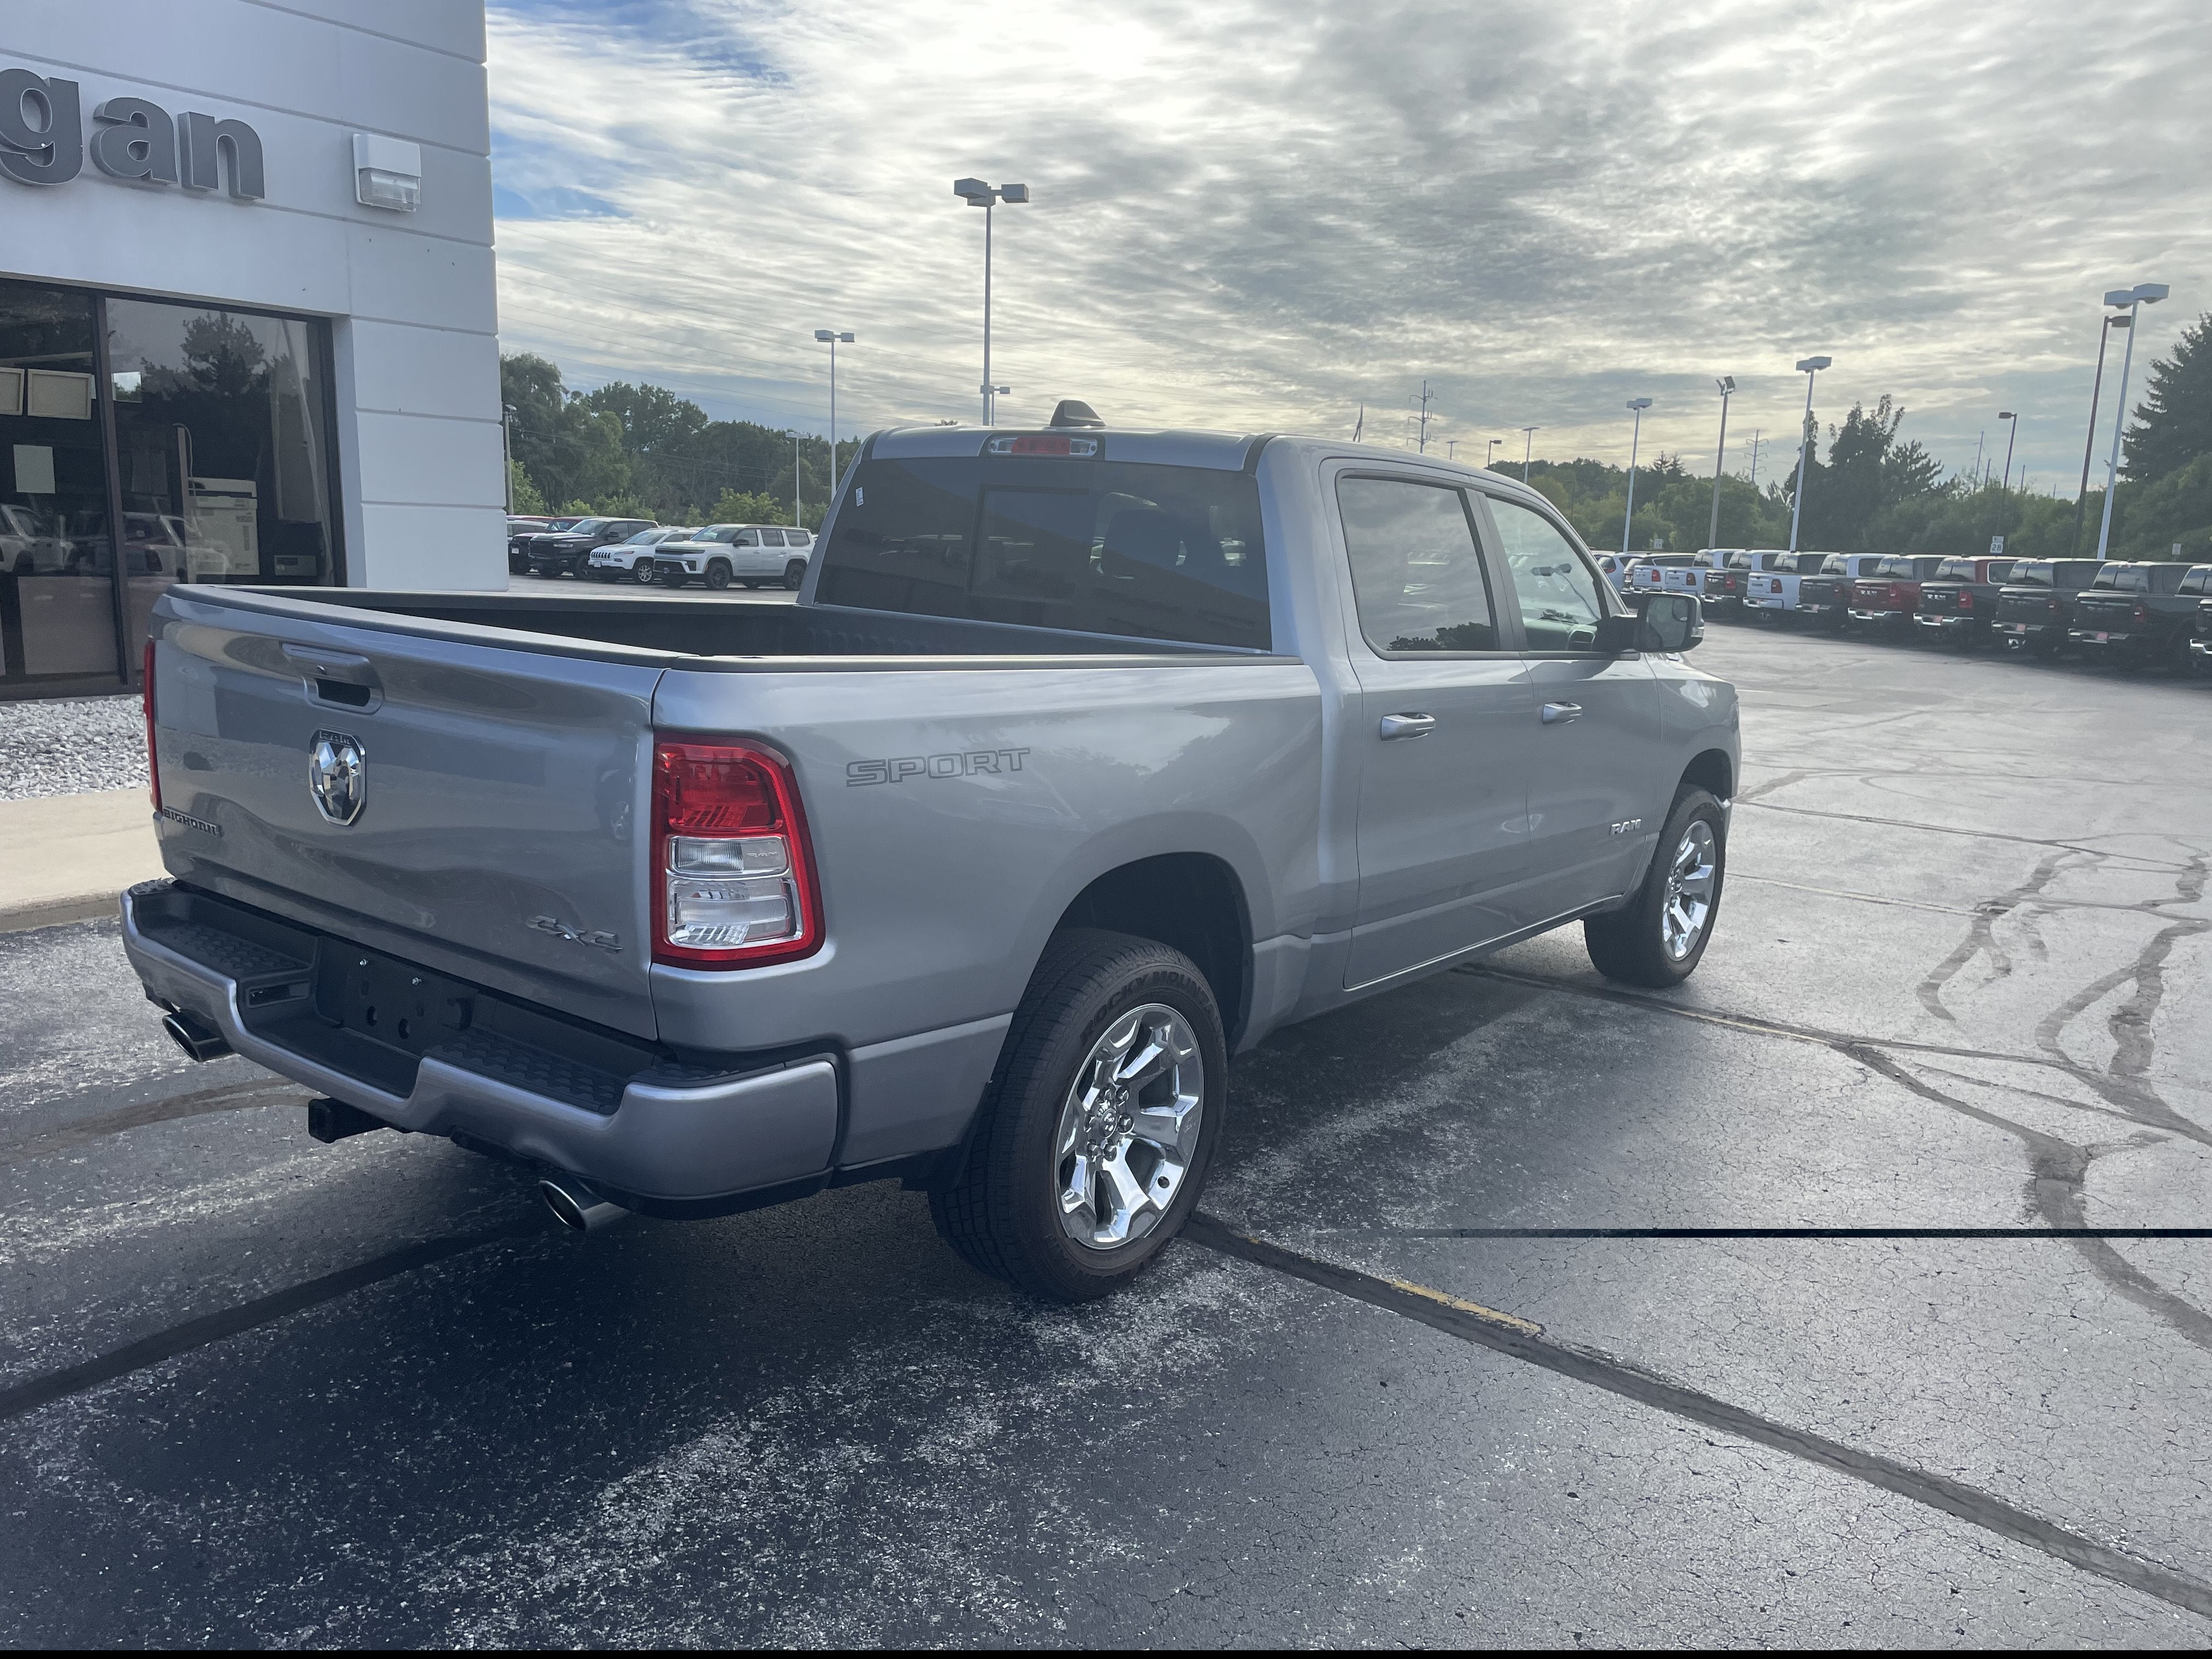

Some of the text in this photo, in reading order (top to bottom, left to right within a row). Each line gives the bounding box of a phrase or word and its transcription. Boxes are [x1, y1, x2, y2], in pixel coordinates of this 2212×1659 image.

[0, 68, 266, 201] gan
[319, 730, 351, 744] RAM
[846, 747, 1031, 788] SPORT
[1610, 819, 1641, 836] RAM
[1080, 973, 1150, 1046] ROCKY
